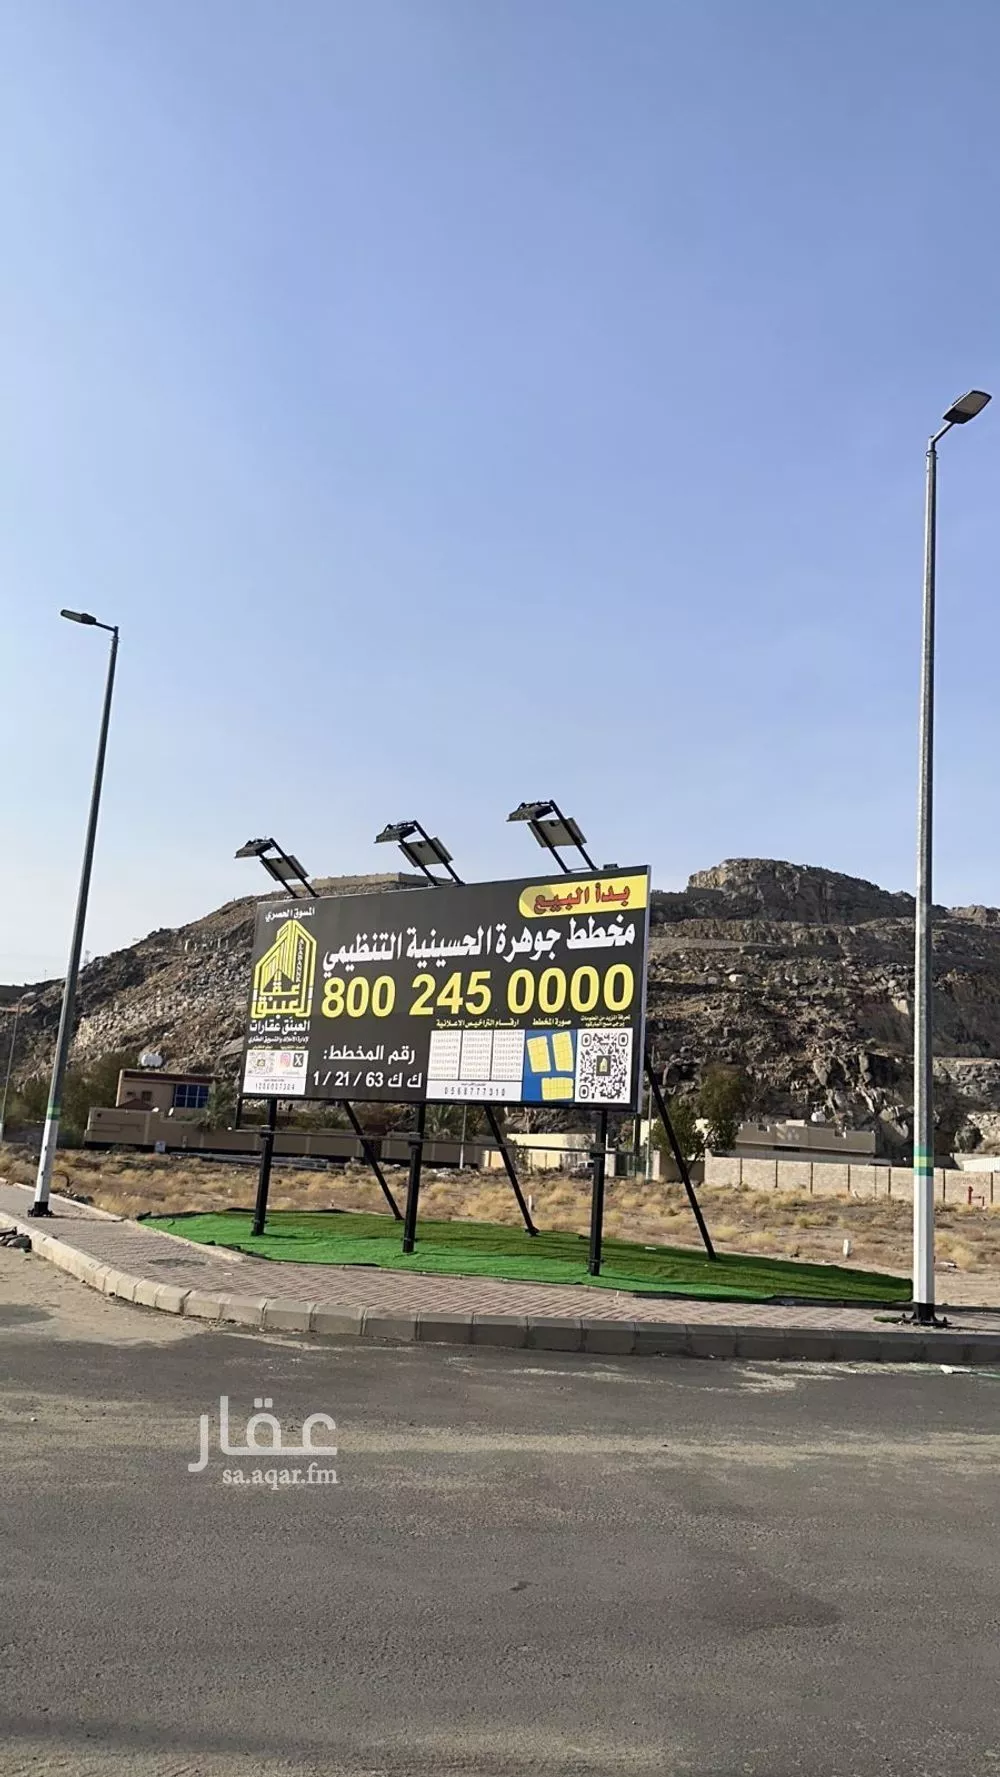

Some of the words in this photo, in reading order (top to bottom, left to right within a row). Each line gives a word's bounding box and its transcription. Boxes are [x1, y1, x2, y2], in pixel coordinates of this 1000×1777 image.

[533, 887, 590, 914] البيع
[594, 882, 631, 906] بدأ
[265, 908, 293, 922] الحصري
[566, 913, 636, 950] مخطط
[406, 925, 492, 969] الحسينية
[495, 922, 561, 963] جوهرة
[322, 931, 402, 978] التنظيمي
[321, 974, 396, 1019] 800
[409, 970, 491, 1016] 245
[507, 963, 634, 1015] 0000
[249, 1018, 281, 1034] عقارات
[323, 1044, 384, 1061] المخطط:
[388, 1045, 415, 1065] رقم
[313, 1071, 319, 1085] 1
[322, 1071, 331, 1086] /
[334, 1071, 349, 1086] 21
[353, 1071, 362, 1086] /
[365, 1071, 383, 1087] 63
[387, 1072, 403, 1088] ك
[407, 1072, 422, 1088] ك
